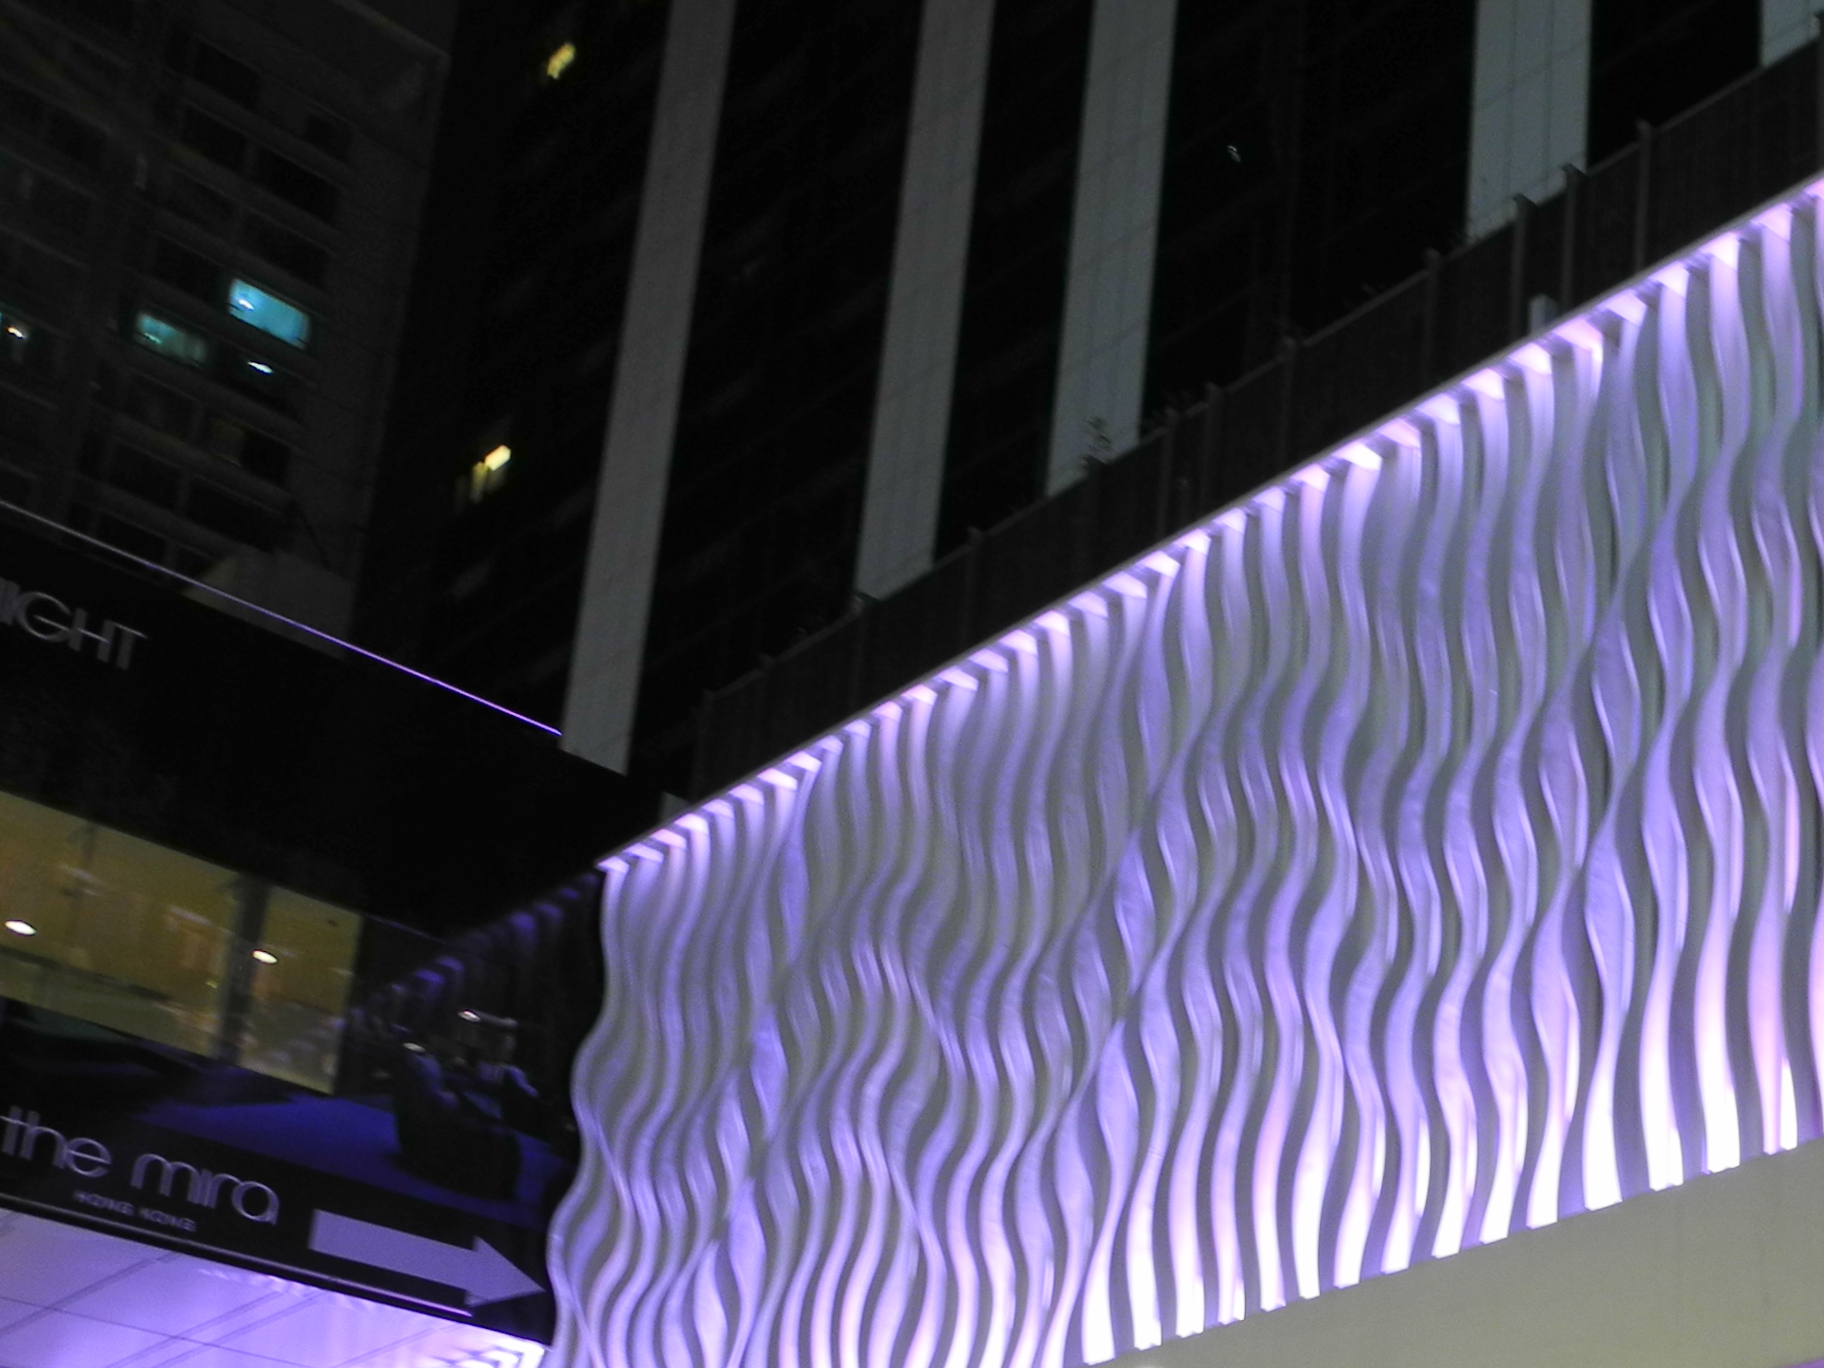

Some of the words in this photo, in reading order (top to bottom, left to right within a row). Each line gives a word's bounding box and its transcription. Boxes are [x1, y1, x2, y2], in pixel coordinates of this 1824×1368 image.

[0, 576, 148, 671] IGHT
[0, 1105, 112, 1178] the
[130, 1153, 280, 1226] mira
